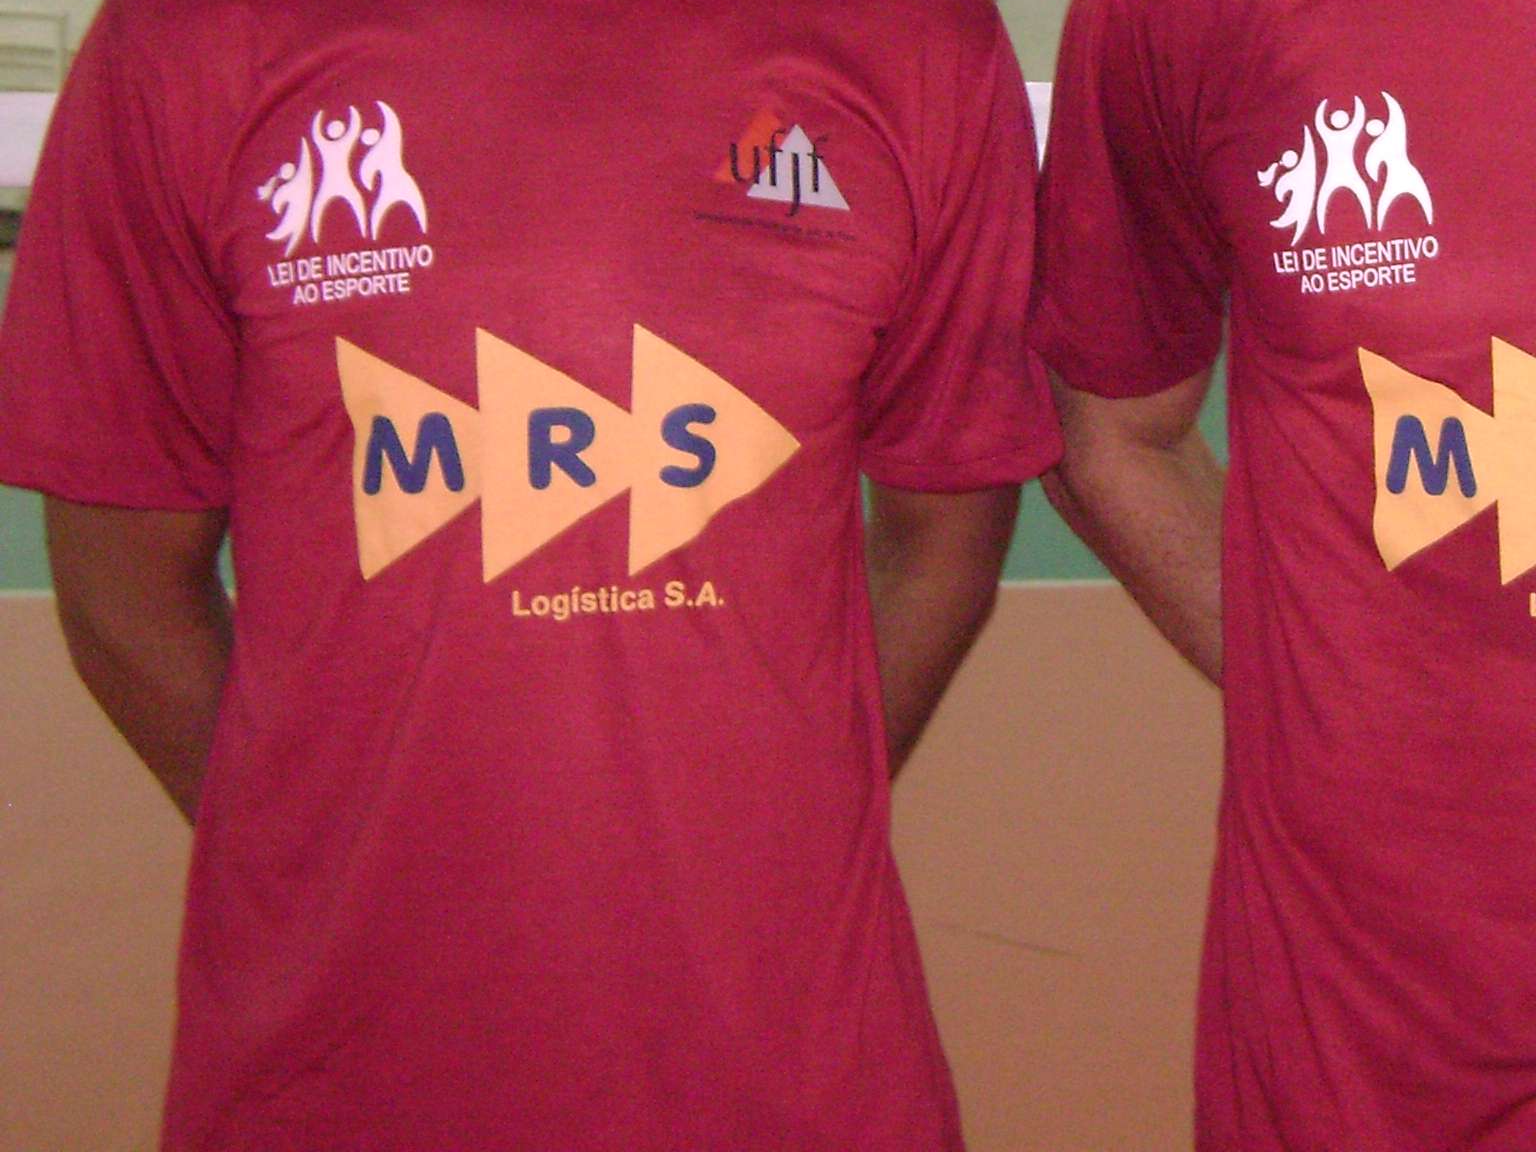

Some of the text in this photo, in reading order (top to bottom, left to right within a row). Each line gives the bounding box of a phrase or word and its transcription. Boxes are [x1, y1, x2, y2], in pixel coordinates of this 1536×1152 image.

[268, 244, 433, 287] LEI DE INCENTIVO
[1273, 235, 1440, 273] LEI DE INCENTIVO
[293, 272, 411, 305] AO ESPORTE
[1301, 263, 1416, 294] AO ESPORTE
[511, 580, 725, 621] Logística S.A.
